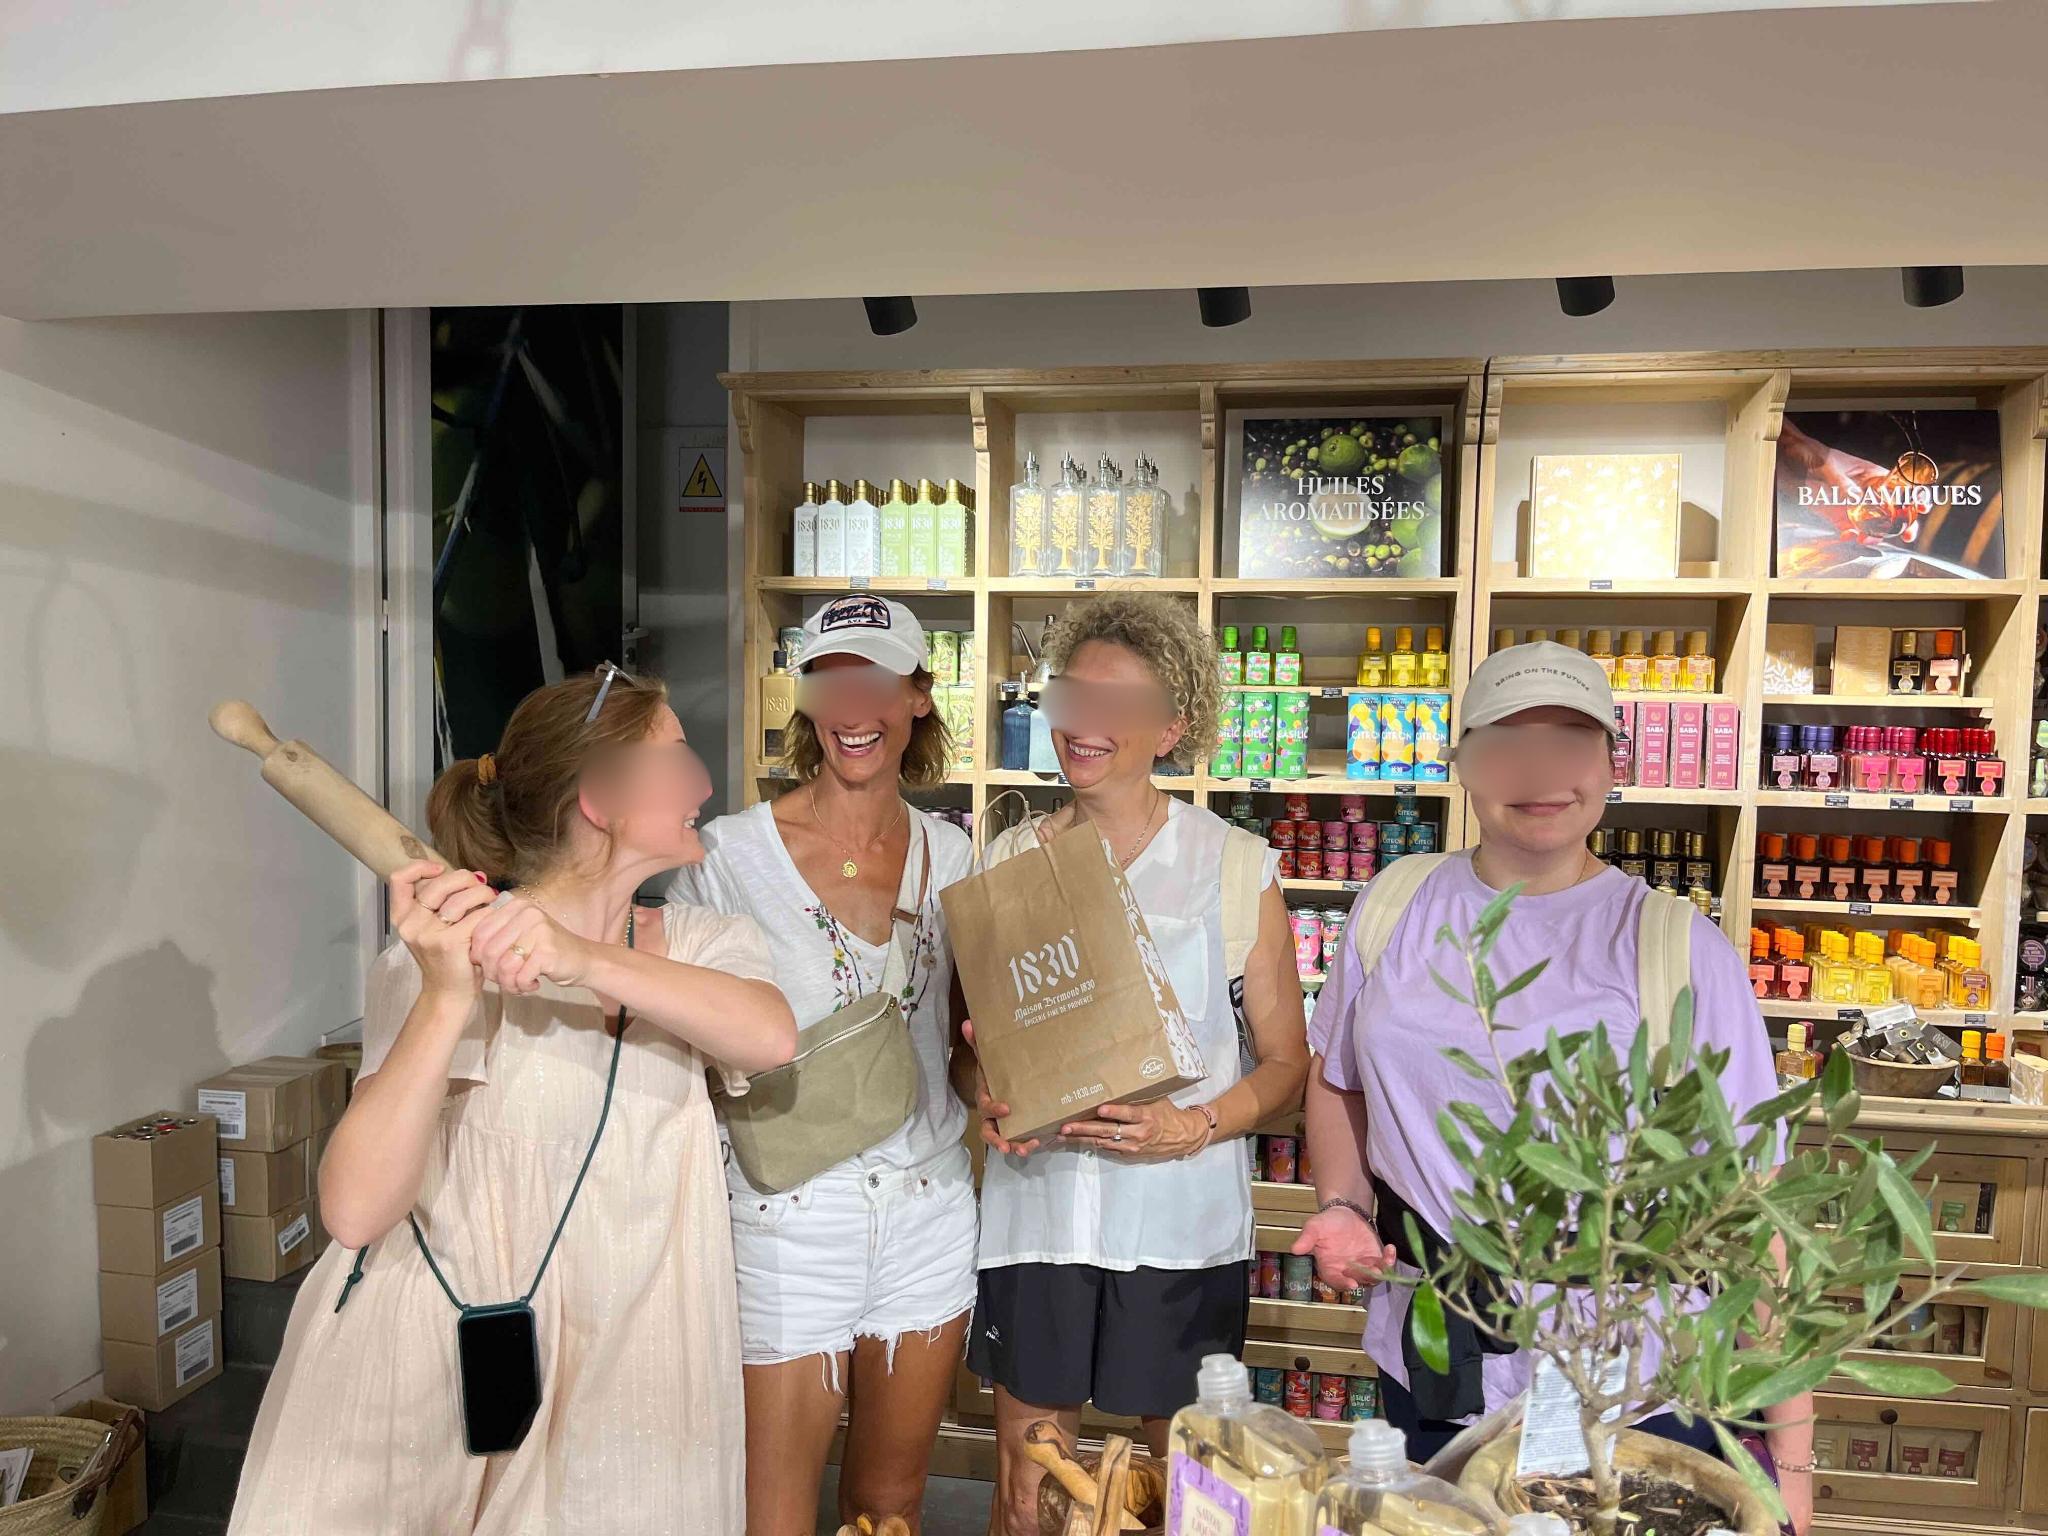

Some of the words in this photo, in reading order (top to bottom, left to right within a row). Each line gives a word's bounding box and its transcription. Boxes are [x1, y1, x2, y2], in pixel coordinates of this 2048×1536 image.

[1298, 476, 1384, 496] HUILES
[1797, 484, 1982, 508] BALSAMIQUES
[1259, 497, 1425, 521] AROMATISÉES
[1495, 671, 1521, 687] BRING
[1541, 667, 1558, 675] THE
[1561, 671, 1590, 691] FUTURE
[768, 696, 789, 712] 1830
[1008, 935, 1080, 1003] 1830
[1013, 1002, 1043, 1022] Maison
[1043, 987, 1080, 1008] Bremond
[1080, 978, 1096, 993] 1830
[1060, 1083, 1104, 1105] mb-1830.com
